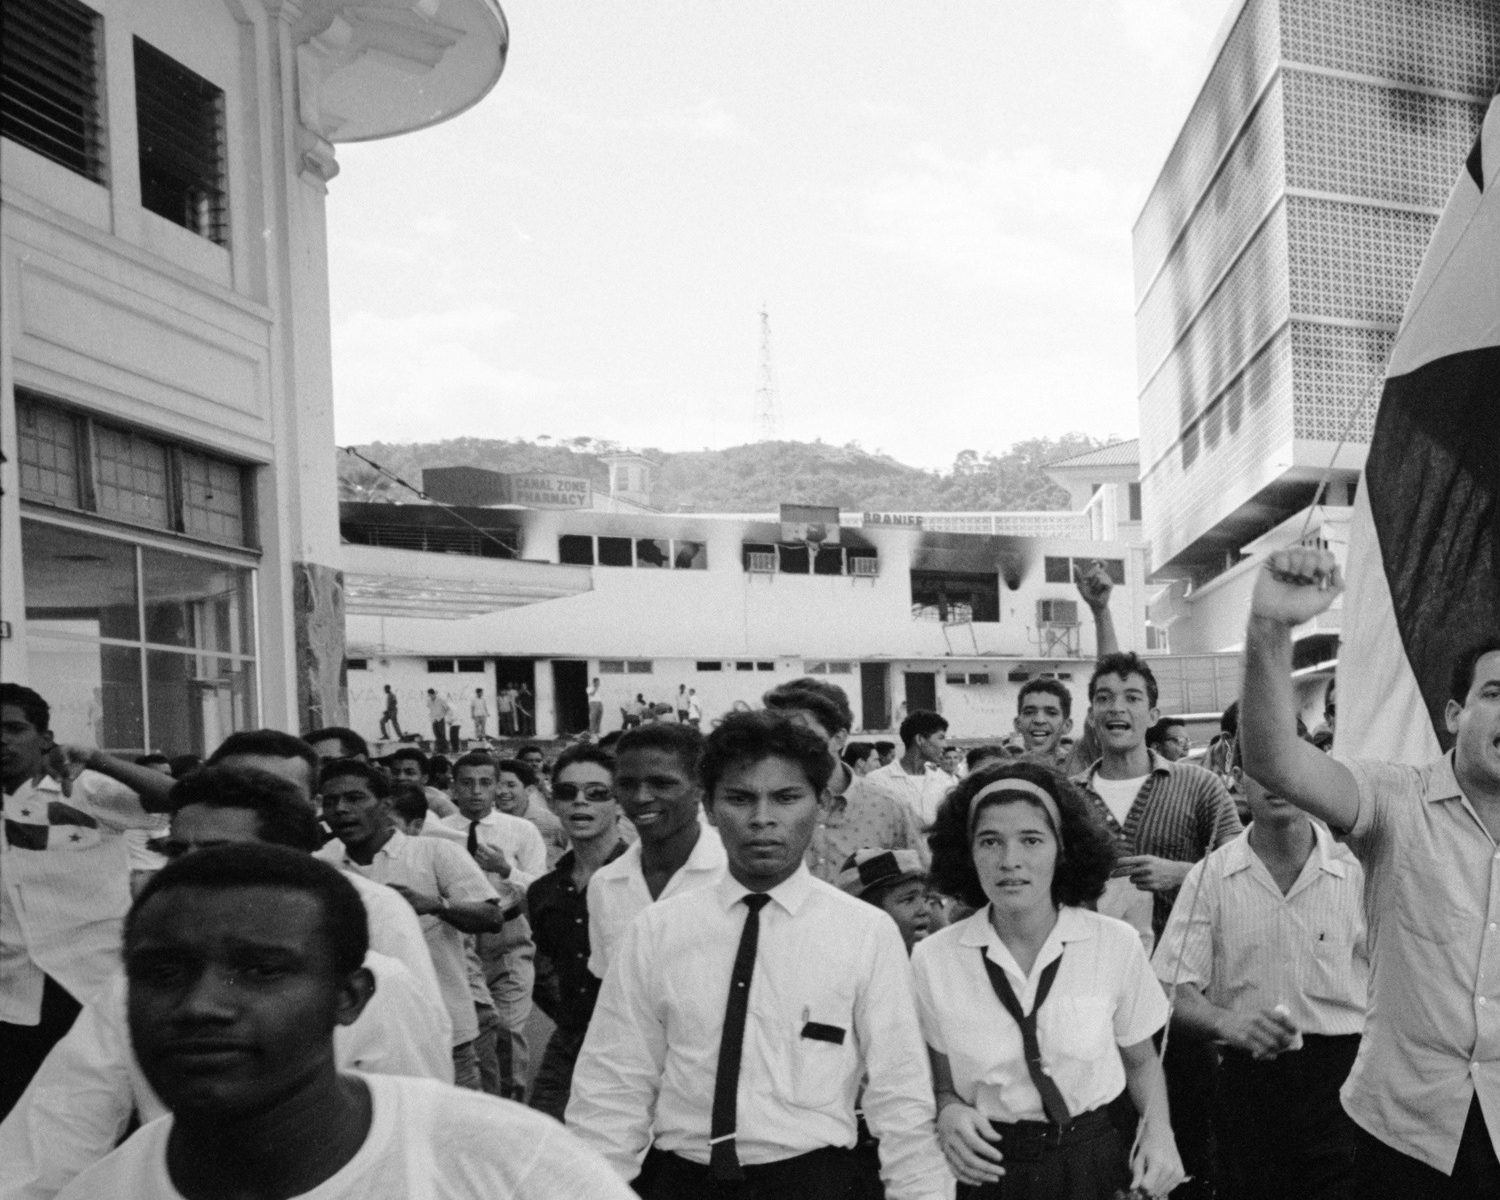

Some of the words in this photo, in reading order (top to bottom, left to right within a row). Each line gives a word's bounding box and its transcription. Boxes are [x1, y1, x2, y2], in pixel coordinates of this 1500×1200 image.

[515, 477, 553, 491] CANAL
[557, 479, 588, 493] ZONE
[516, 491, 586, 506] PHARMACY
[863, 512, 923, 526] BRANIFF
